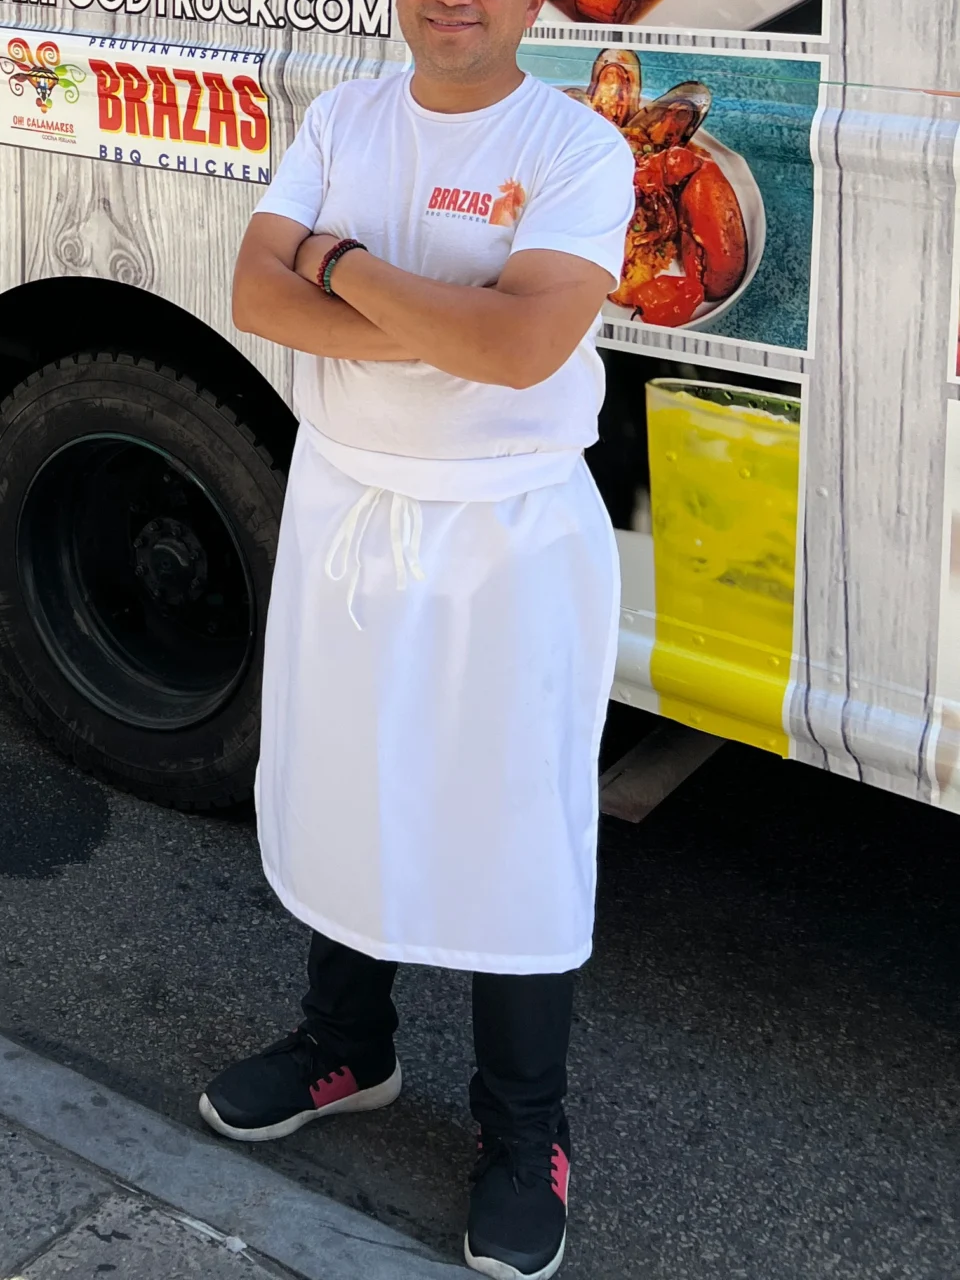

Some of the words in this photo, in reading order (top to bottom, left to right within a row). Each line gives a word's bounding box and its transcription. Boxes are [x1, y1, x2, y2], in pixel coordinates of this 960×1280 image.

[89, 37, 170, 55] PERUVIAN
[179, 46, 264, 64] INSPIRED
[88, 58, 270, 154] BRAZAS
[12, 115, 24, 126] OH!
[26, 117, 74, 134] CALAMARES
[99, 144, 142, 166] BBQ
[158, 153, 270, 183] CHICKEN
[428, 187, 492, 216] BRAZAS
[425, 209, 441, 217] BBQ
[445, 212, 487, 224] CHICKEN
